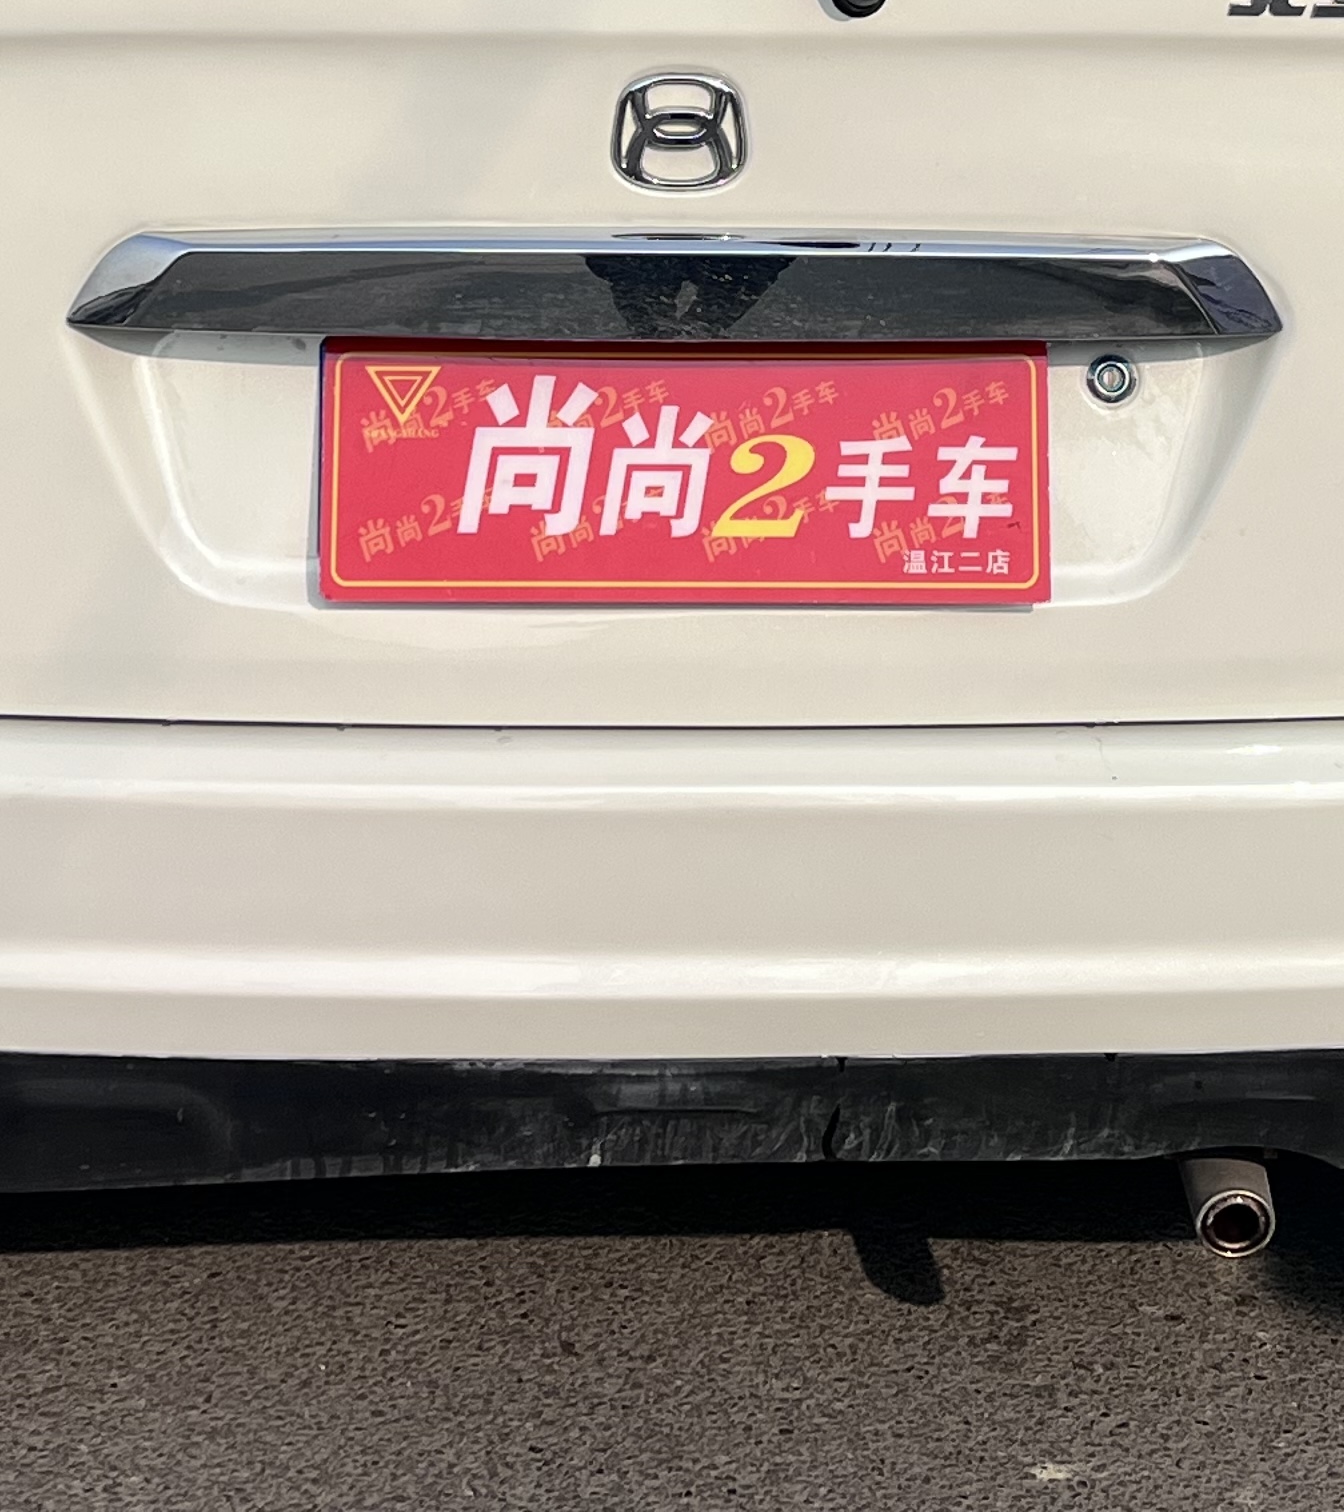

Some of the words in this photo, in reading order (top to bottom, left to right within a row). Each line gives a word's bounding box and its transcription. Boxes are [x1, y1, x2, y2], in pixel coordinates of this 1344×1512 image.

[456, 374, 1018, 539] 尚尚2手车
[902, 549, 1011, 575] 温江二店
